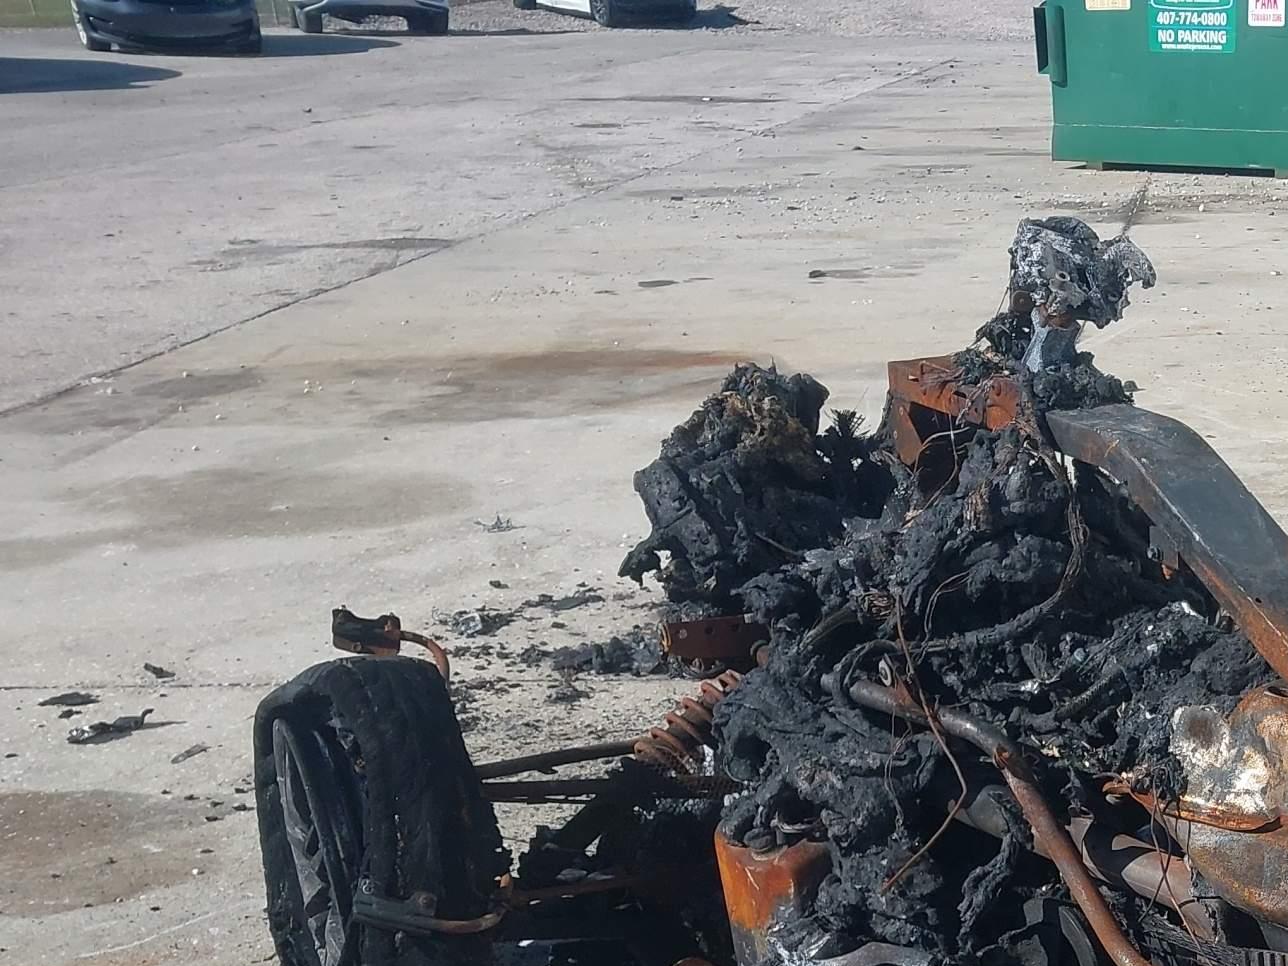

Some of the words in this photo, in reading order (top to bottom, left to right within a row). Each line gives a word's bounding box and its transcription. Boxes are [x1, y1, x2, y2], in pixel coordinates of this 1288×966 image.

[1156, 11, 1227, 26] 407-774-0800
[1157, 29, 1175, 43] NO
[1177, 29, 1227, 44] PARKING
